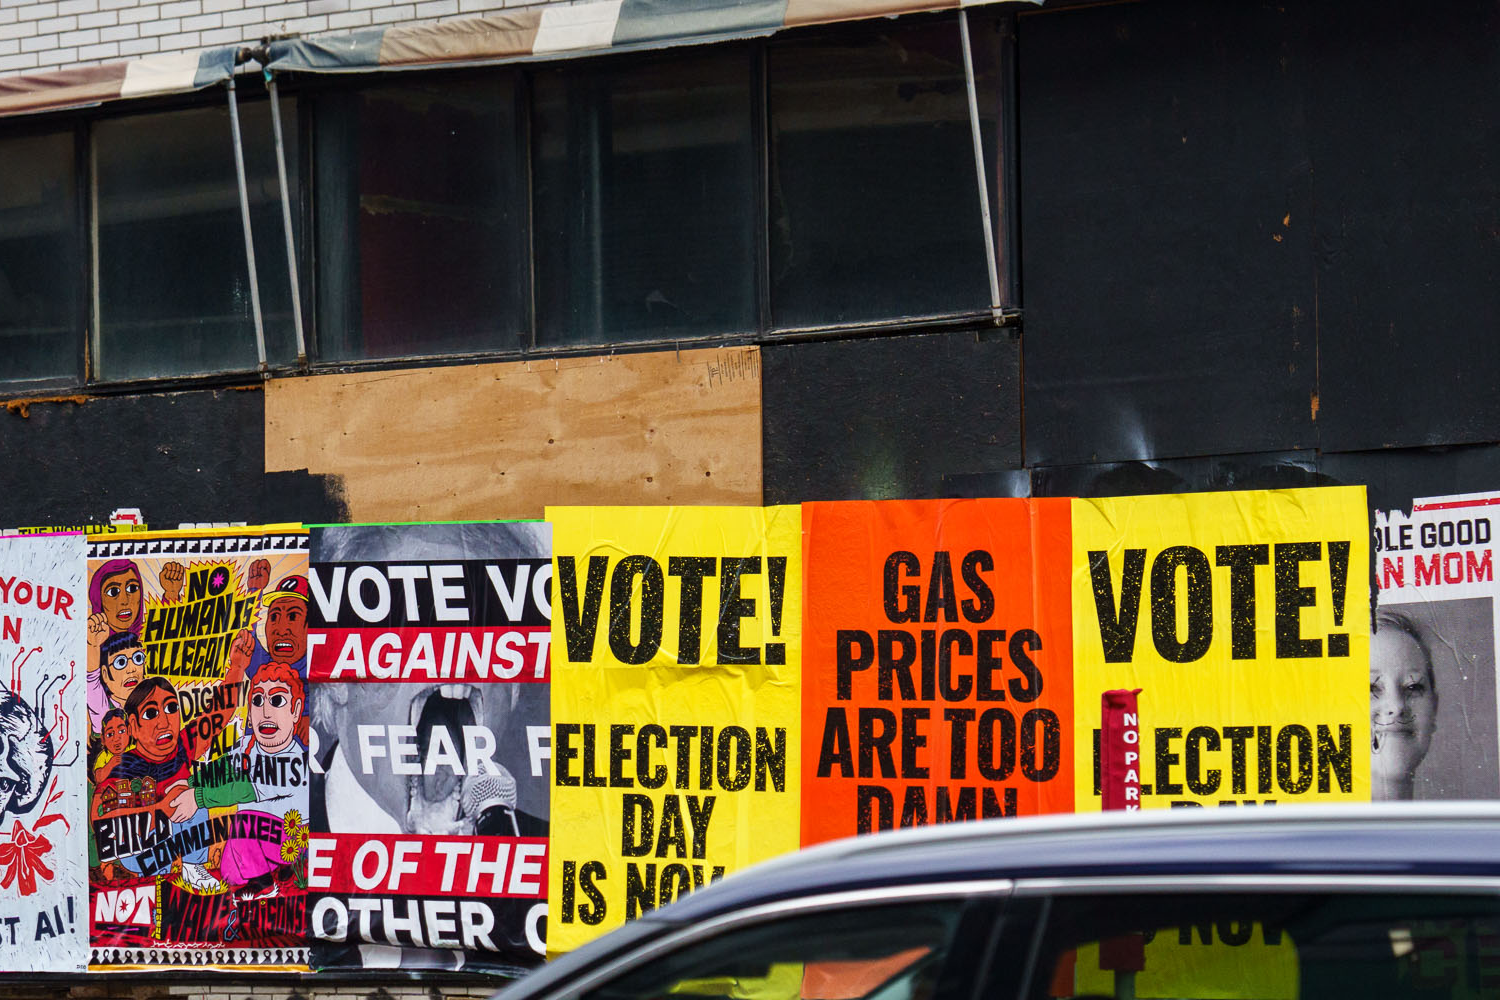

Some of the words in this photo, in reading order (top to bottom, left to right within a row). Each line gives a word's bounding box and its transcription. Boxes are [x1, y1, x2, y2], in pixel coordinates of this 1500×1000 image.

[1420, 518, 1491, 549] GOOD
[188, 566, 230, 602] NO
[309, 565, 470, 623] VOTE
[883, 549, 997, 625] GAS
[1414, 549, 1494, 587] MOM
[144, 592, 233, 642] HUMAN
[232, 596, 257, 630] IS
[557, 555, 788, 666] VOTE!
[1087, 540, 1351, 664] VOTE!
[146, 632, 234, 679] ILLEGAL!
[329, 632, 552, 680] AGAINST
[836, 628, 1044, 704] PRICES
[179, 679, 250, 721] DIGNITY
[185, 714, 224, 748] FOR
[209, 721, 241, 761] ALL
[357, 725, 501, 776] FEAR
[817, 707, 929, 780] ARE
[944, 707, 1060, 783] TOO
[1123, 713, 1138, 744] NO
[190, 753, 308, 788] IMMIGRANTS!
[555, 723, 787, 793] ELECTION
[1092, 723, 1353, 796] ECTION
[93, 809, 173, 863] BUILD
[136, 814, 285, 878] COMMUNITIES
[620, 793, 717, 860] DAY
[352, 839, 423, 890] OF
[434, 841, 547, 895] THE
[35, 896, 76, 942] AI!
[95, 885, 156, 926] NOT
[561, 861, 607, 926] IS
[312, 897, 501, 952] OTHER
